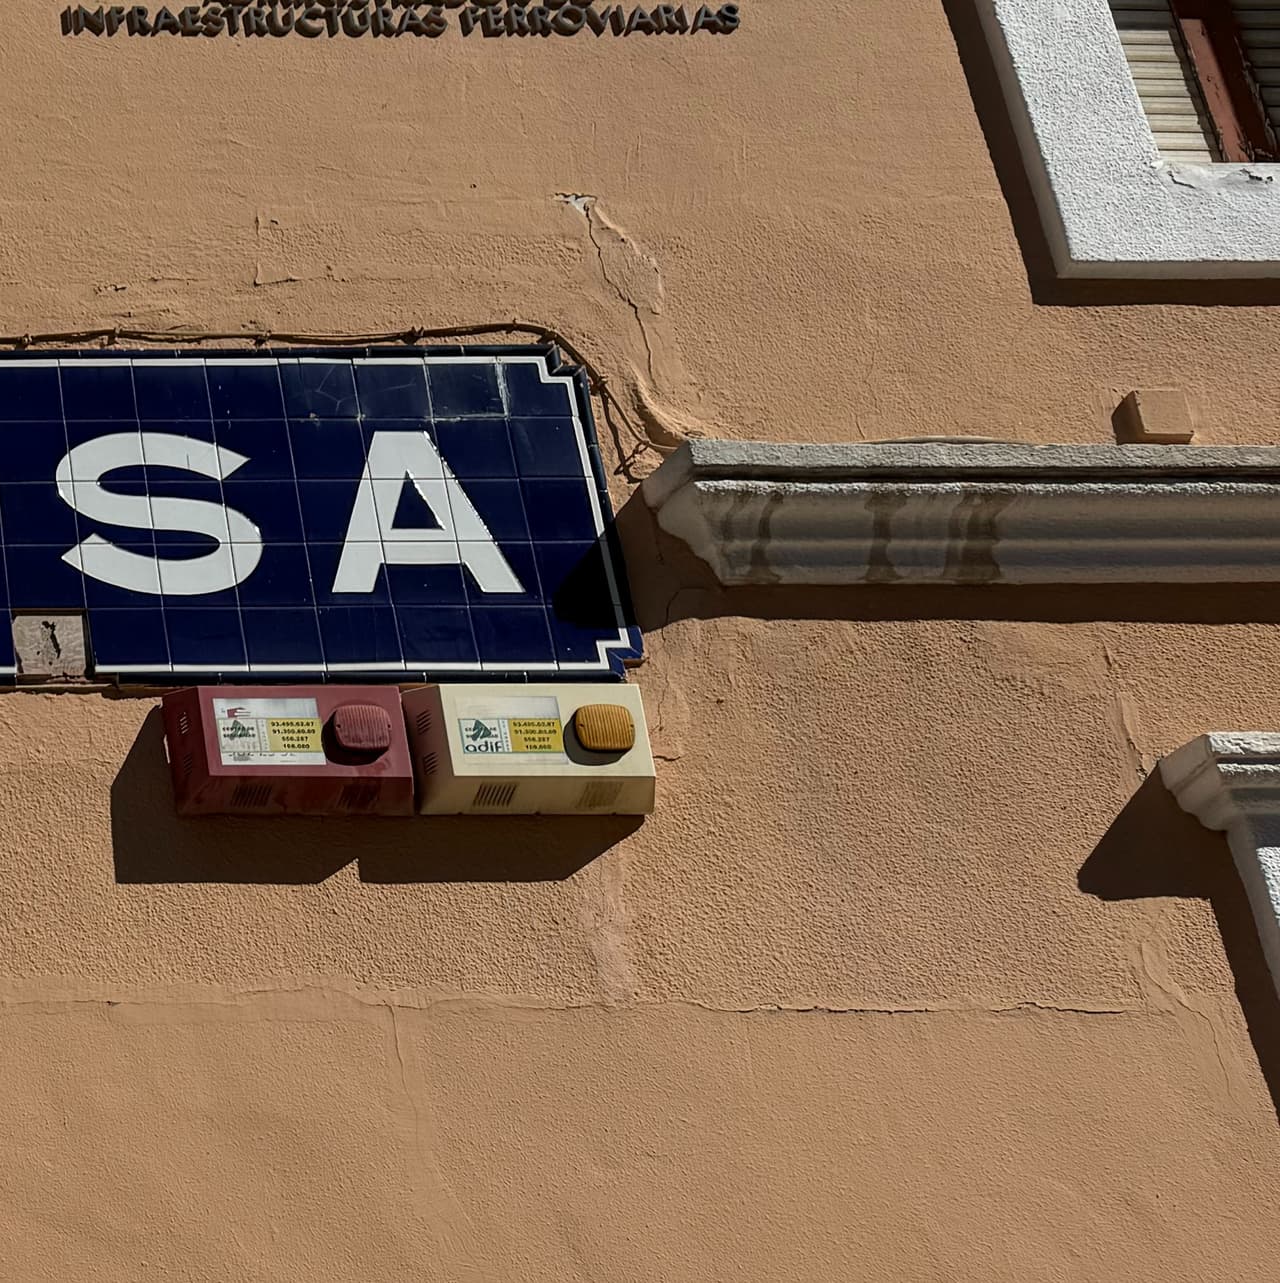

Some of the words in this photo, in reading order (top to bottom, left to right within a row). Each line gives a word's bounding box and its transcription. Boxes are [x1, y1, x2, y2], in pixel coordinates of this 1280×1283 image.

[60, 5, 448, 38] INFRAESTRUCTURAS
[459, 4, 740, 37] FERROVIARIAS
[465, 740, 503, 752] adif
